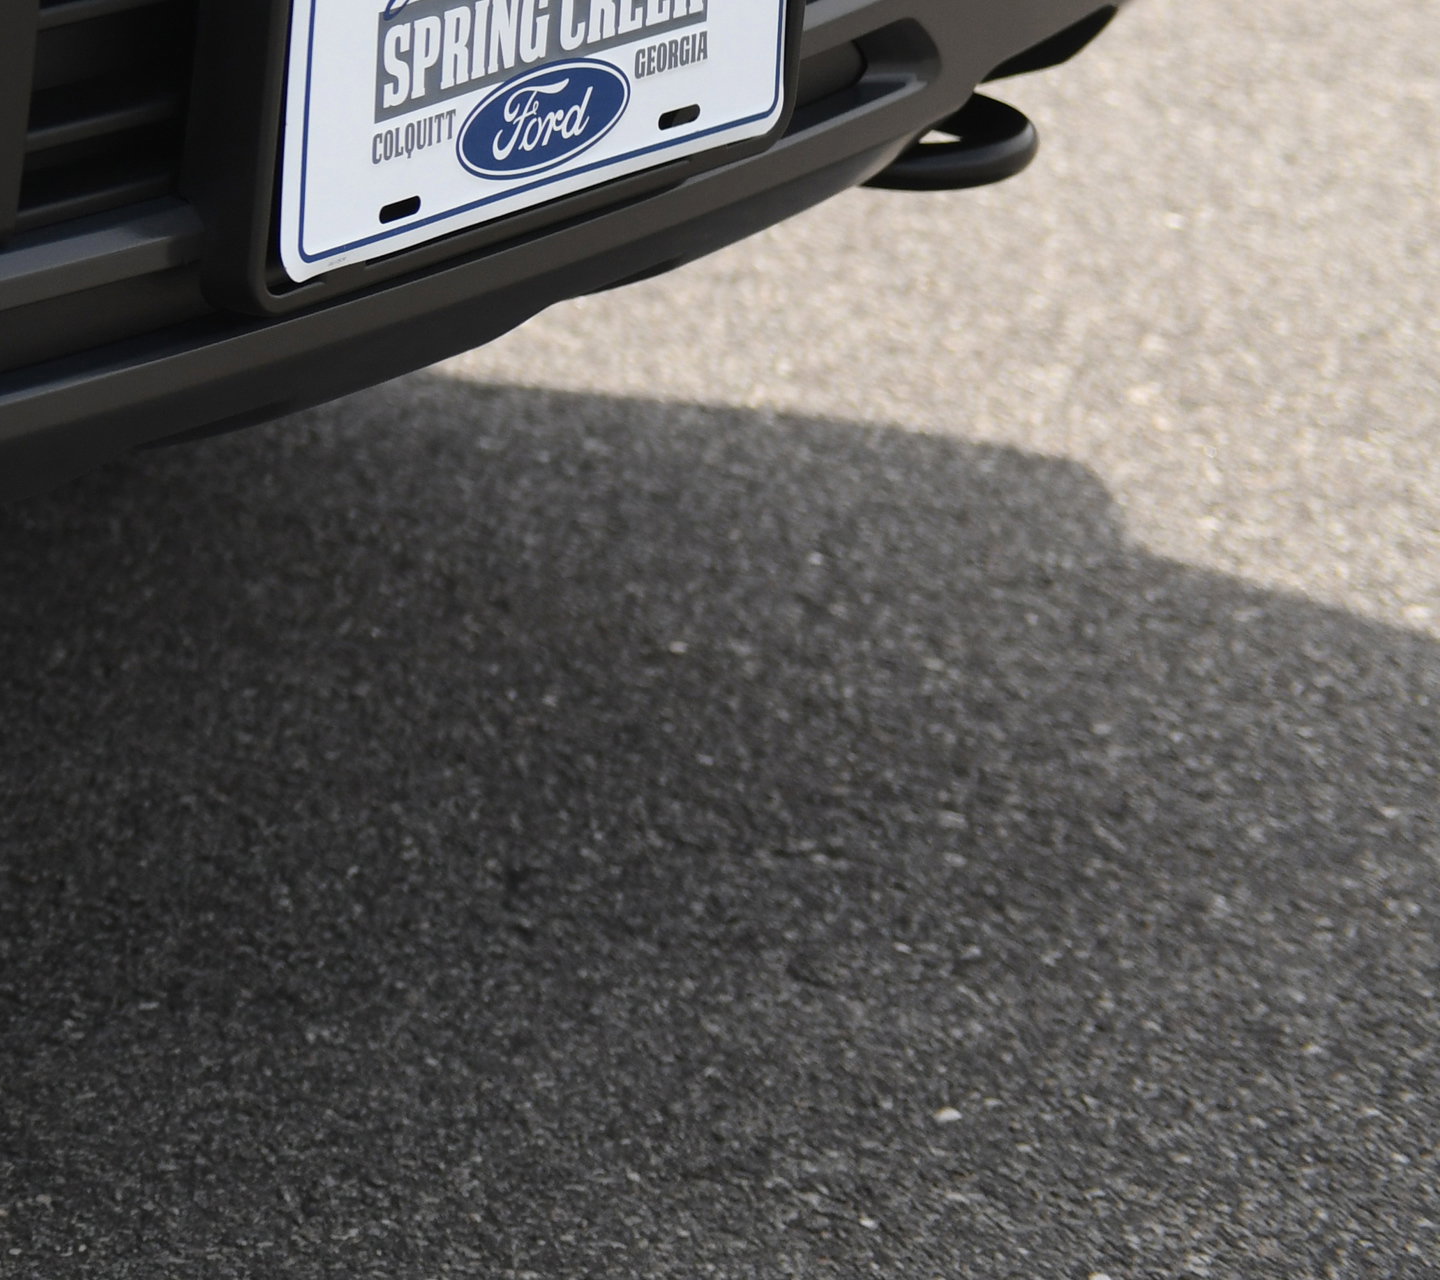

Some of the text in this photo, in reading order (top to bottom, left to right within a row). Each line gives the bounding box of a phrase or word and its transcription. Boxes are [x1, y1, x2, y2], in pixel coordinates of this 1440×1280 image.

[634, 31, 708, 81] GEORGIA
[371, 109, 457, 167] COLQUITT
[491, 77, 594, 162] Ford
